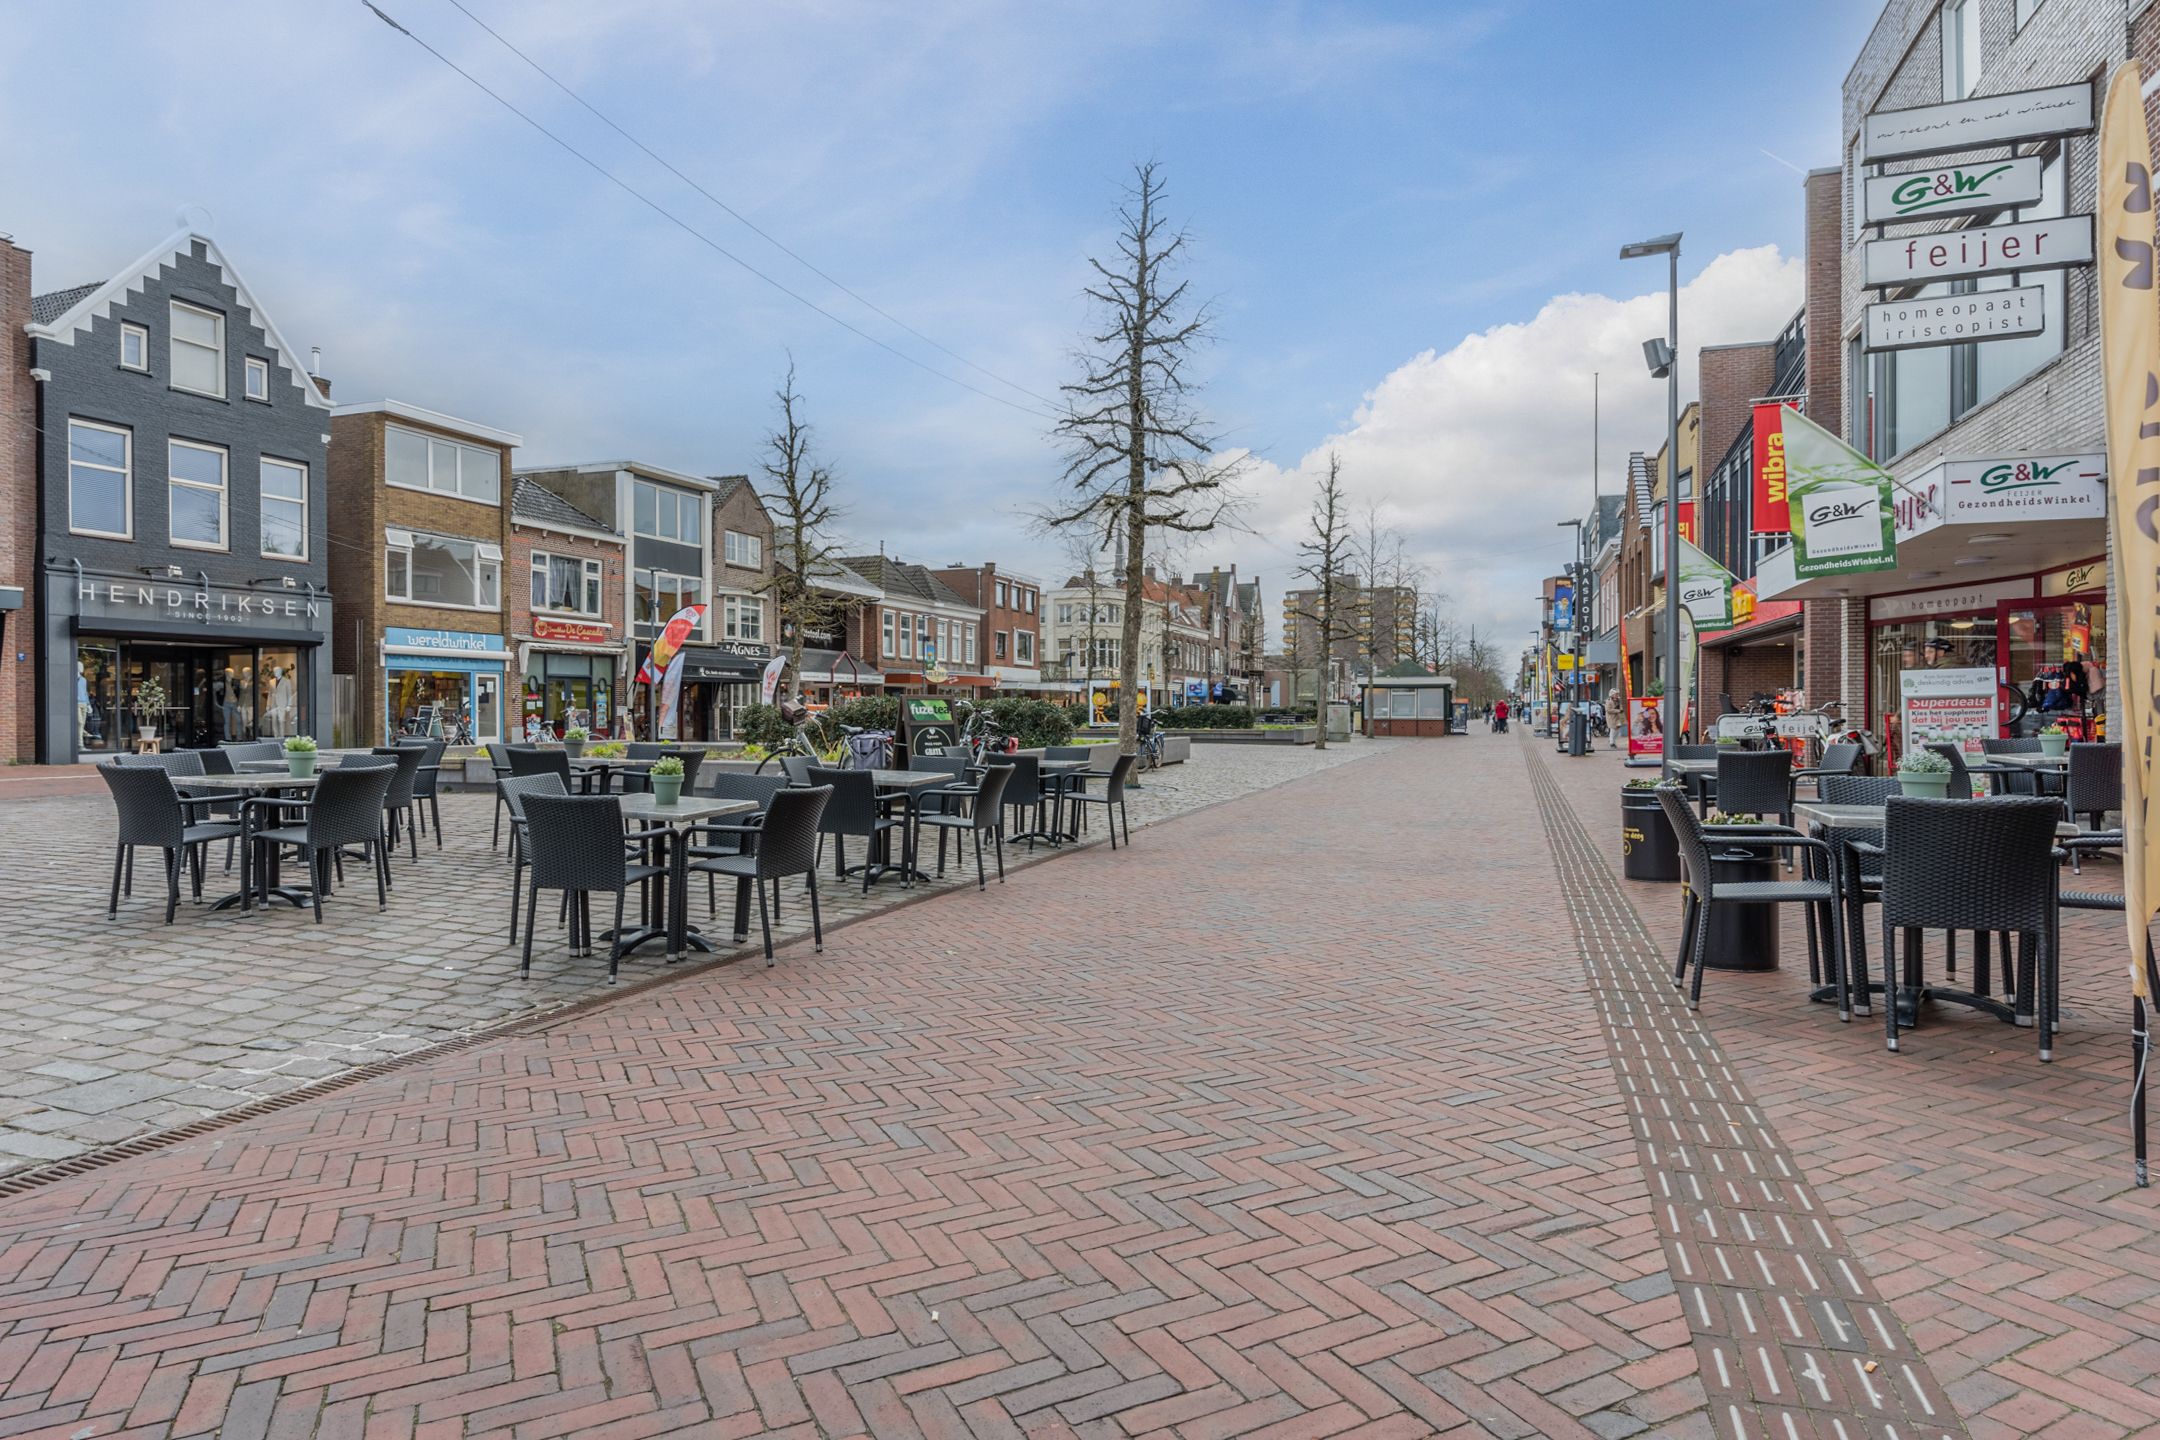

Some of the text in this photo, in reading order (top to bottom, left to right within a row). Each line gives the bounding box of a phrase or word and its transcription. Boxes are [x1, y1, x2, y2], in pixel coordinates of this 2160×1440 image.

[1891, 165, 2014, 206] G&W
[1905, 232, 2048, 270] feijer
[1883, 296, 2025, 323] homeopaat
[1885, 315, 2023, 341] iriscopist
[1762, 432, 1786, 504] wibra
[1980, 460, 2080, 487] G&W
[1958, 494, 2091, 509] GezondheidsWinkel
[2007, 489, 2043, 497] FEIJER
[1809, 499, 1876, 522] G&W
[1798, 555, 1894, 573] GezondheidsWinkel.nl
[2066, 565, 2095, 588] G&W
[78, 583, 320, 618] HENDRIKSEN
[1581, 567, 1592, 634] PASFOTO
[1683, 586, 1722, 601] G&W
[1911, 593, 1983, 610] homeopaat
[174, 611, 243, 623] SINCE 1902
[407, 630, 487, 650] wereldwinkel
[1912, 698, 1986, 709] Superdeals
[1944, 709, 1988, 717] supplement
[1782, 723, 1816, 737] feije
[1930, 716, 1943, 725] bij
[1945, 716, 1961, 725] jou
[1963, 716, 1988, 724] past!
